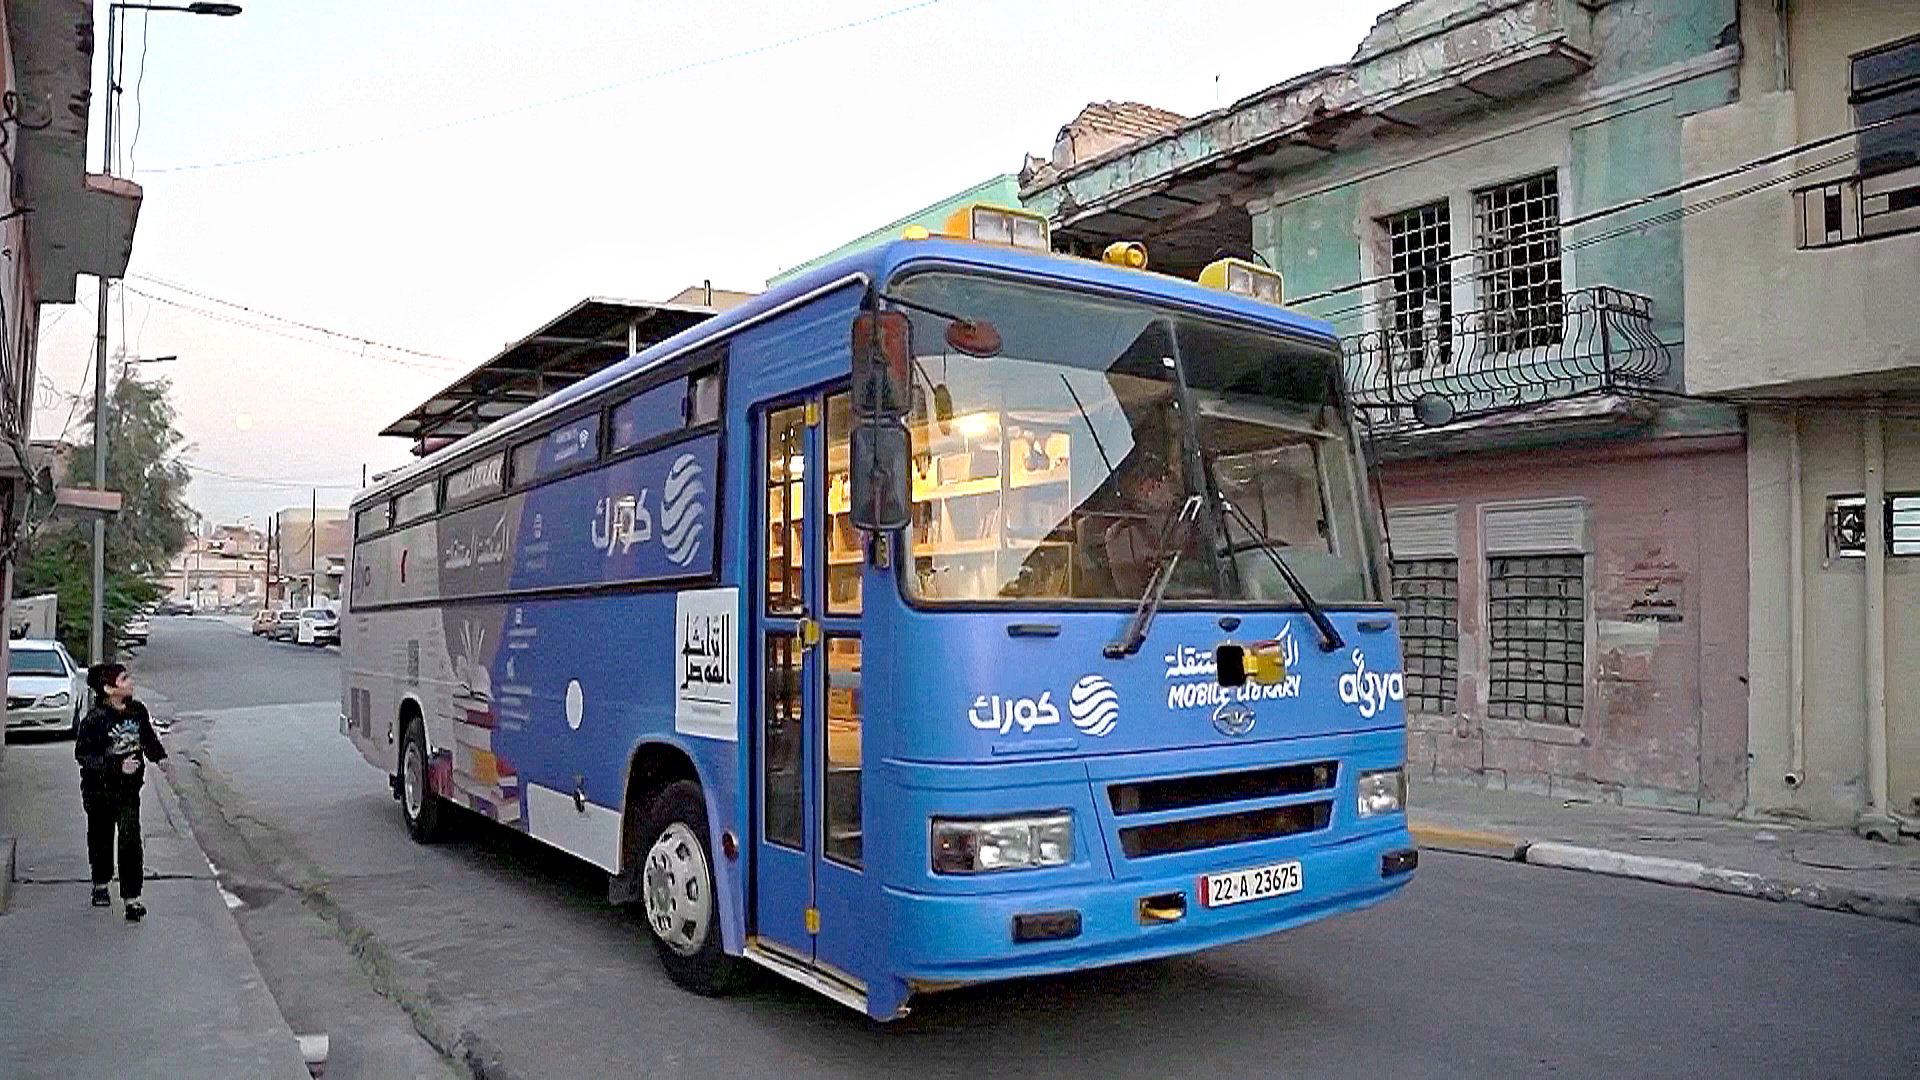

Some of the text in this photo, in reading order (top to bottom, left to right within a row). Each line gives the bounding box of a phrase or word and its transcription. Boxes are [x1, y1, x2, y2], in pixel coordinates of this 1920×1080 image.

[968, 691, 1060, 735] كورك
[1239, 875, 1249, 897] A
[1254, 865, 1298, 895] 23675
